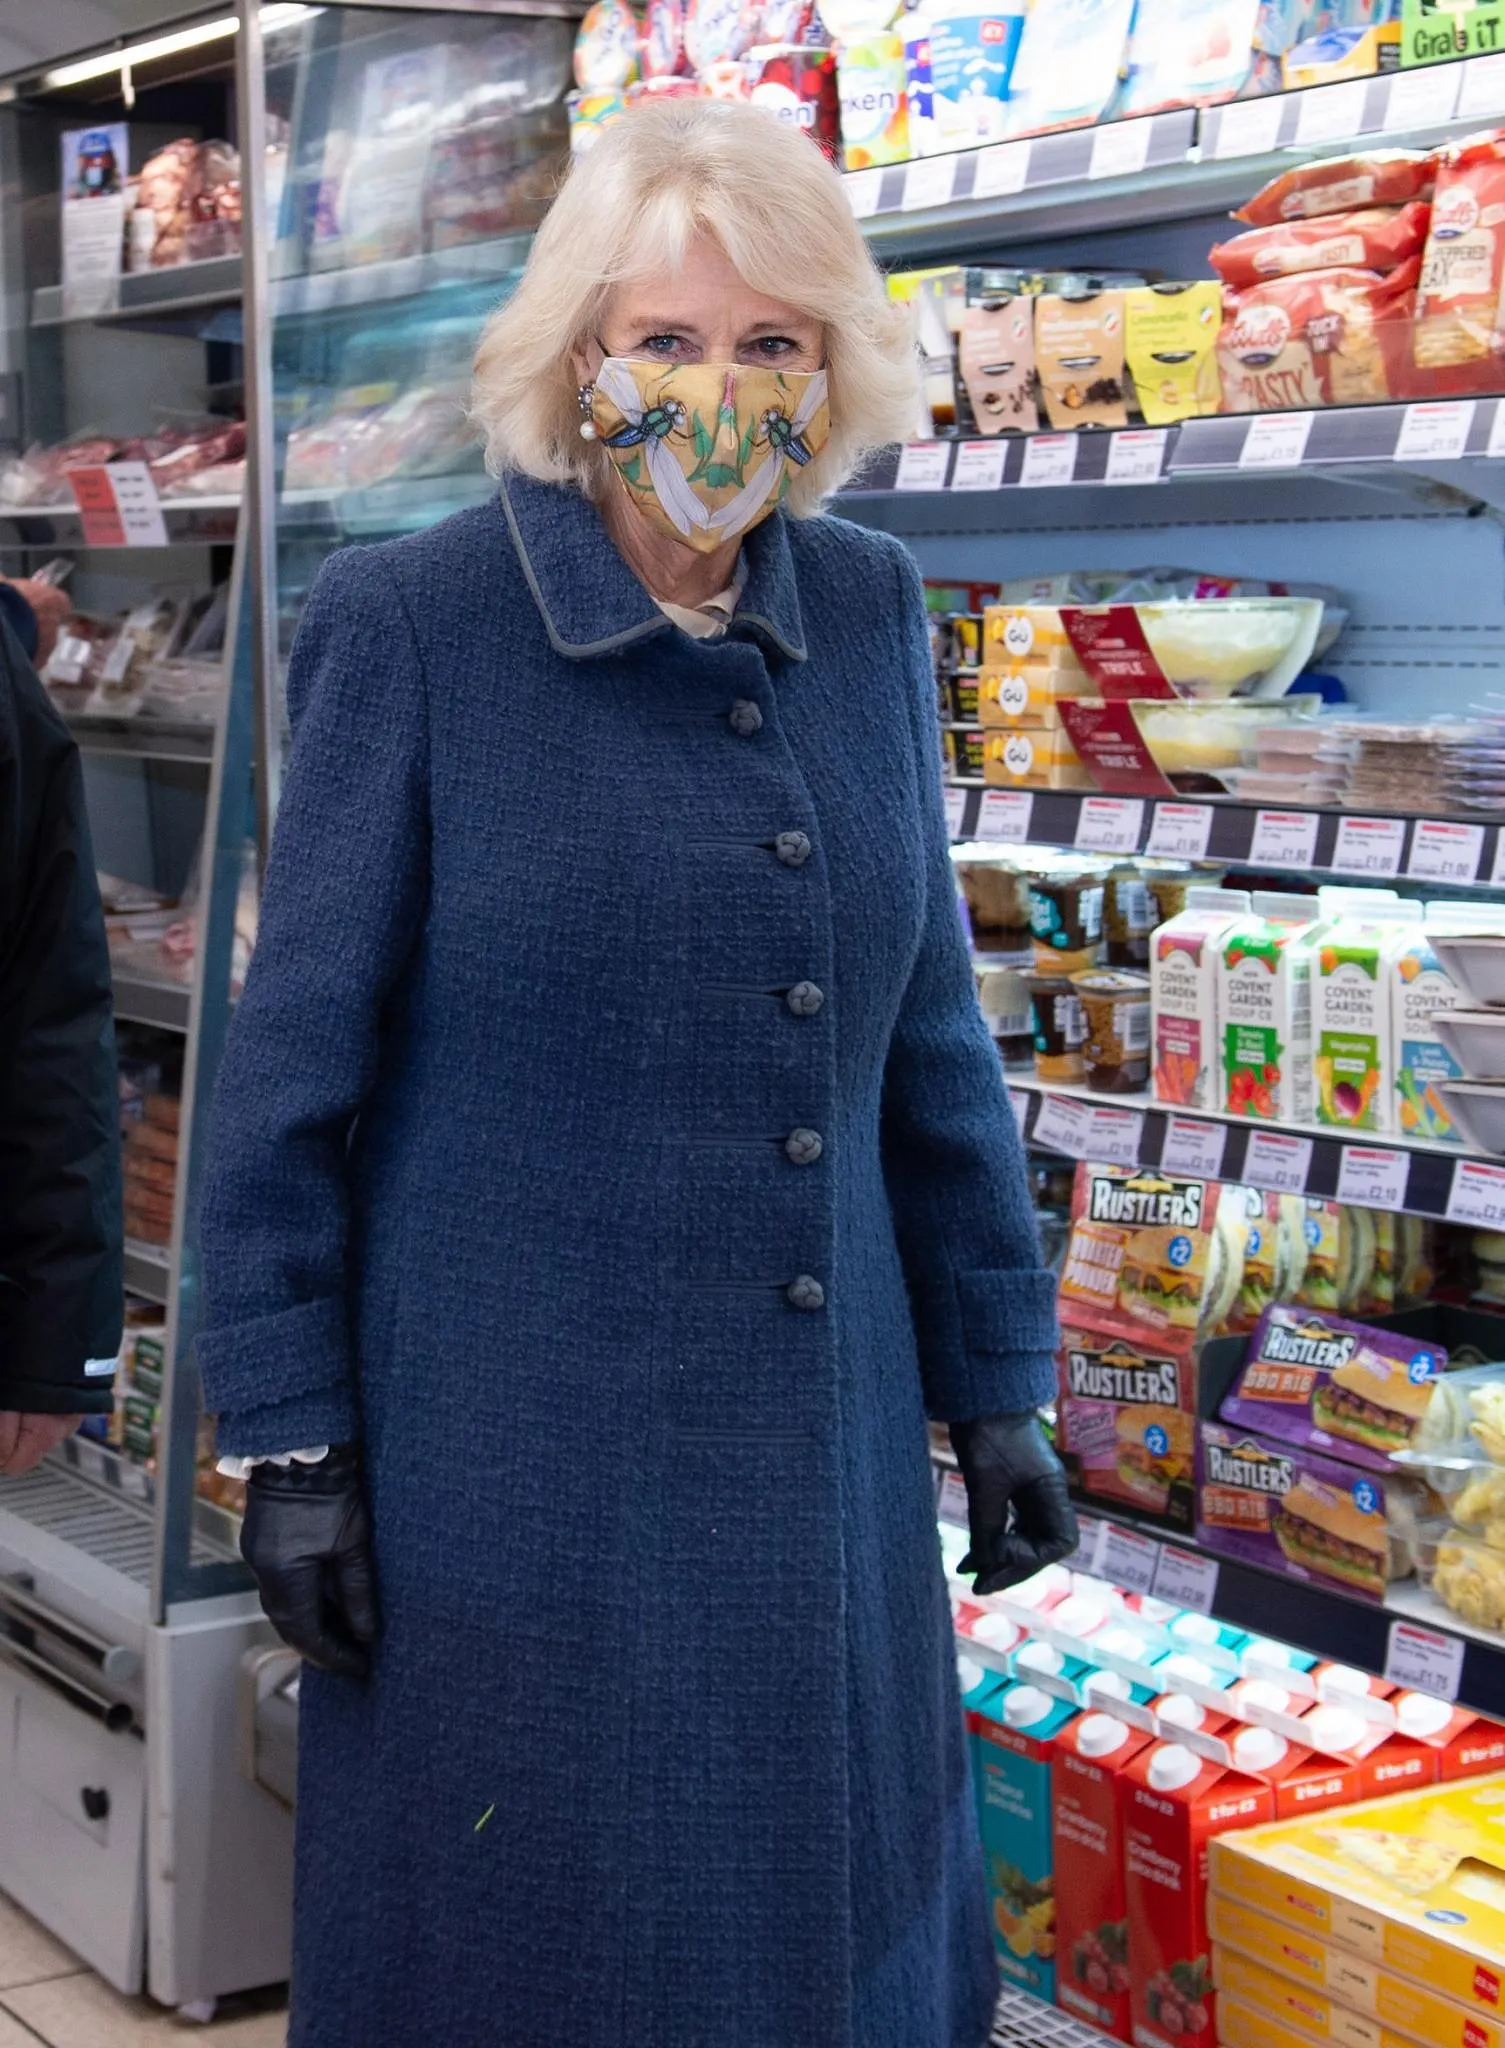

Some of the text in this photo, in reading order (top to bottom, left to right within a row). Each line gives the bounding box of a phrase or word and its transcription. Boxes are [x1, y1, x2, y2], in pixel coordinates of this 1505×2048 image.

[1159, 970, 1197, 984] COVENT
[1159, 984, 1197, 999] GARDEN
[1228, 979, 1272, 994] COVENT
[1324, 986, 1373, 999] COVENT
[1228, 993, 1273, 1008] GARDEN
[1324, 1000, 1374, 1014] GARDEN
[1404, 994, 1456, 1008] COVENT
[1093, 1178, 1201, 1228] RUSTLERS
[1264, 1326, 1356, 1371] RUSTLERS
[1071, 1353, 1177, 1405] RUSTLERS
[1209, 1447, 1292, 1495] RUSTLERS
